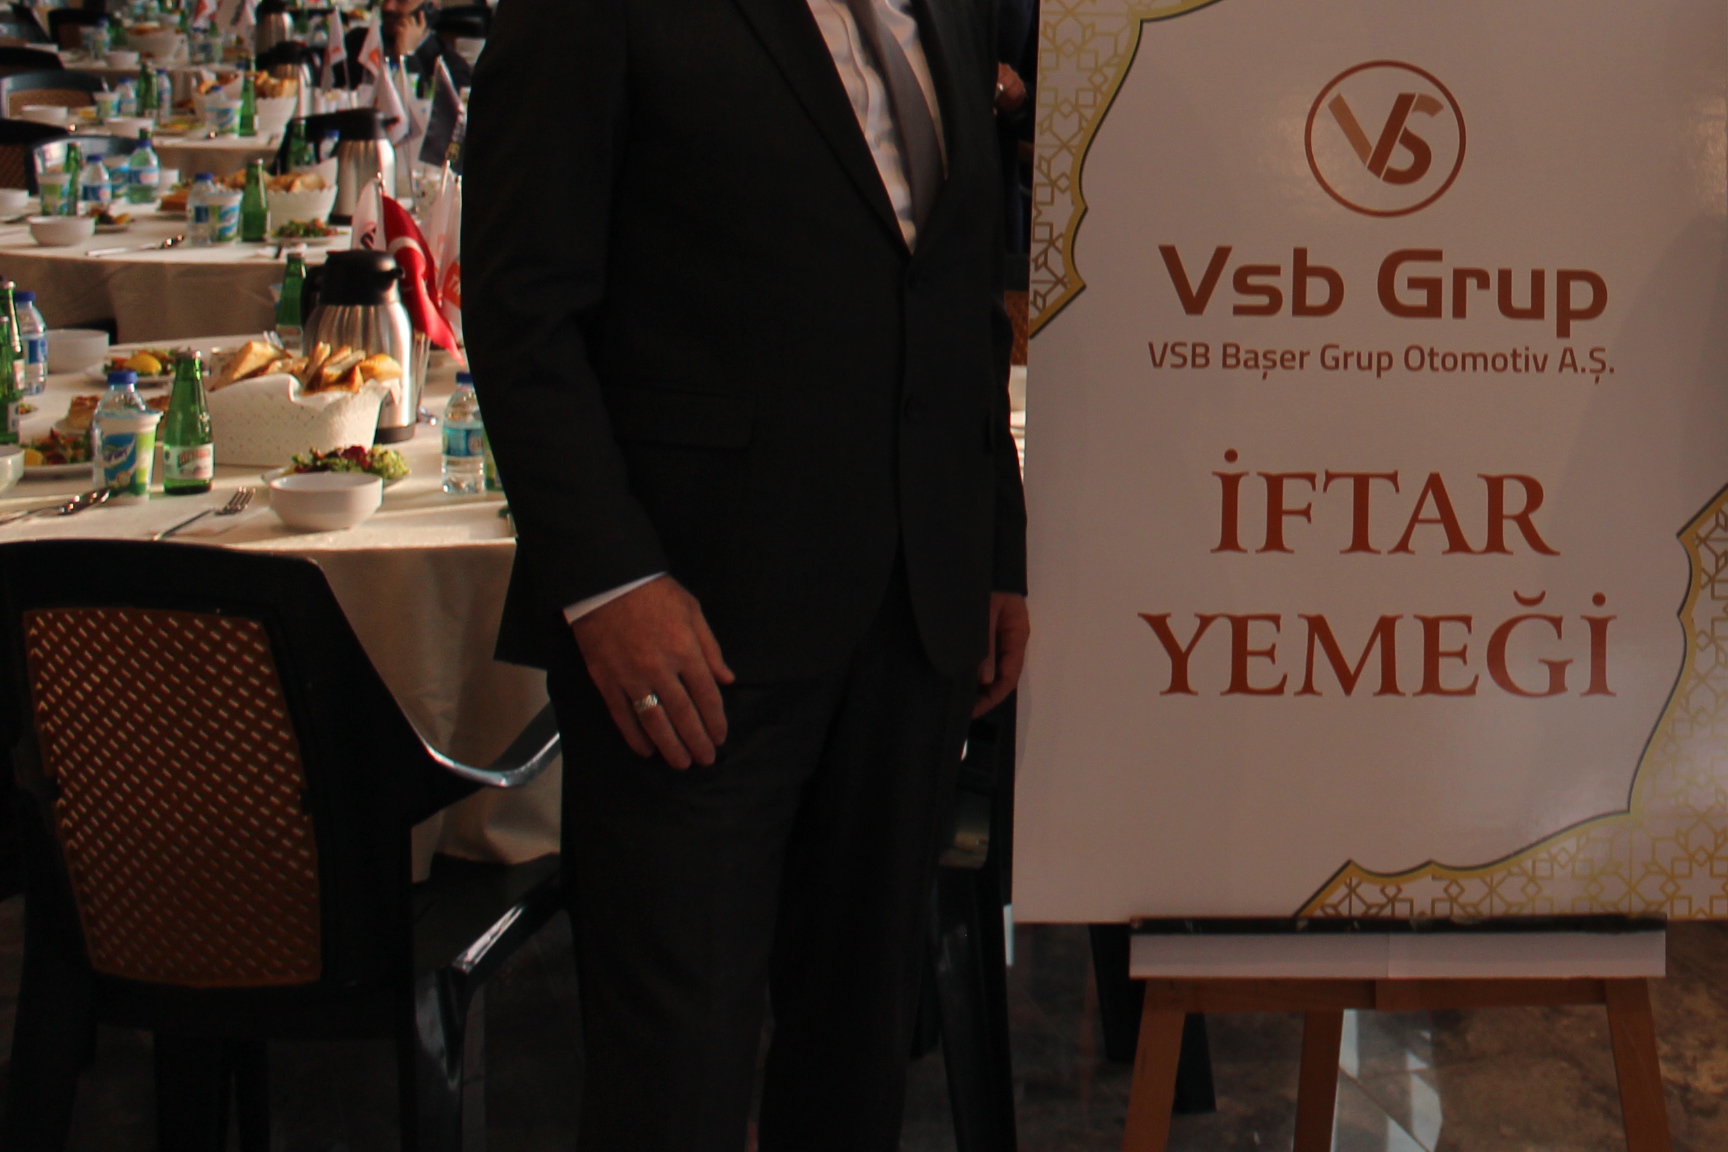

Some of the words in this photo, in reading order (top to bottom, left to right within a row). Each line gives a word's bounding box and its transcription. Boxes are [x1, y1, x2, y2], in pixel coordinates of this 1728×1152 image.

[1158, 245, 1345, 318] Vsb
[1377, 249, 1608, 339] Grup
[1148, 341, 1211, 370] VSB
[1221, 342, 1311, 381] Başer
[1319, 343, 1394, 379] Grup
[1403, 345, 1549, 374] Otomotiv
[1558, 346, 1615, 385] A.Ş.
[1209, 448, 1562, 557] İFTAR
[1137, 590, 1617, 697] YEMEĞİ
